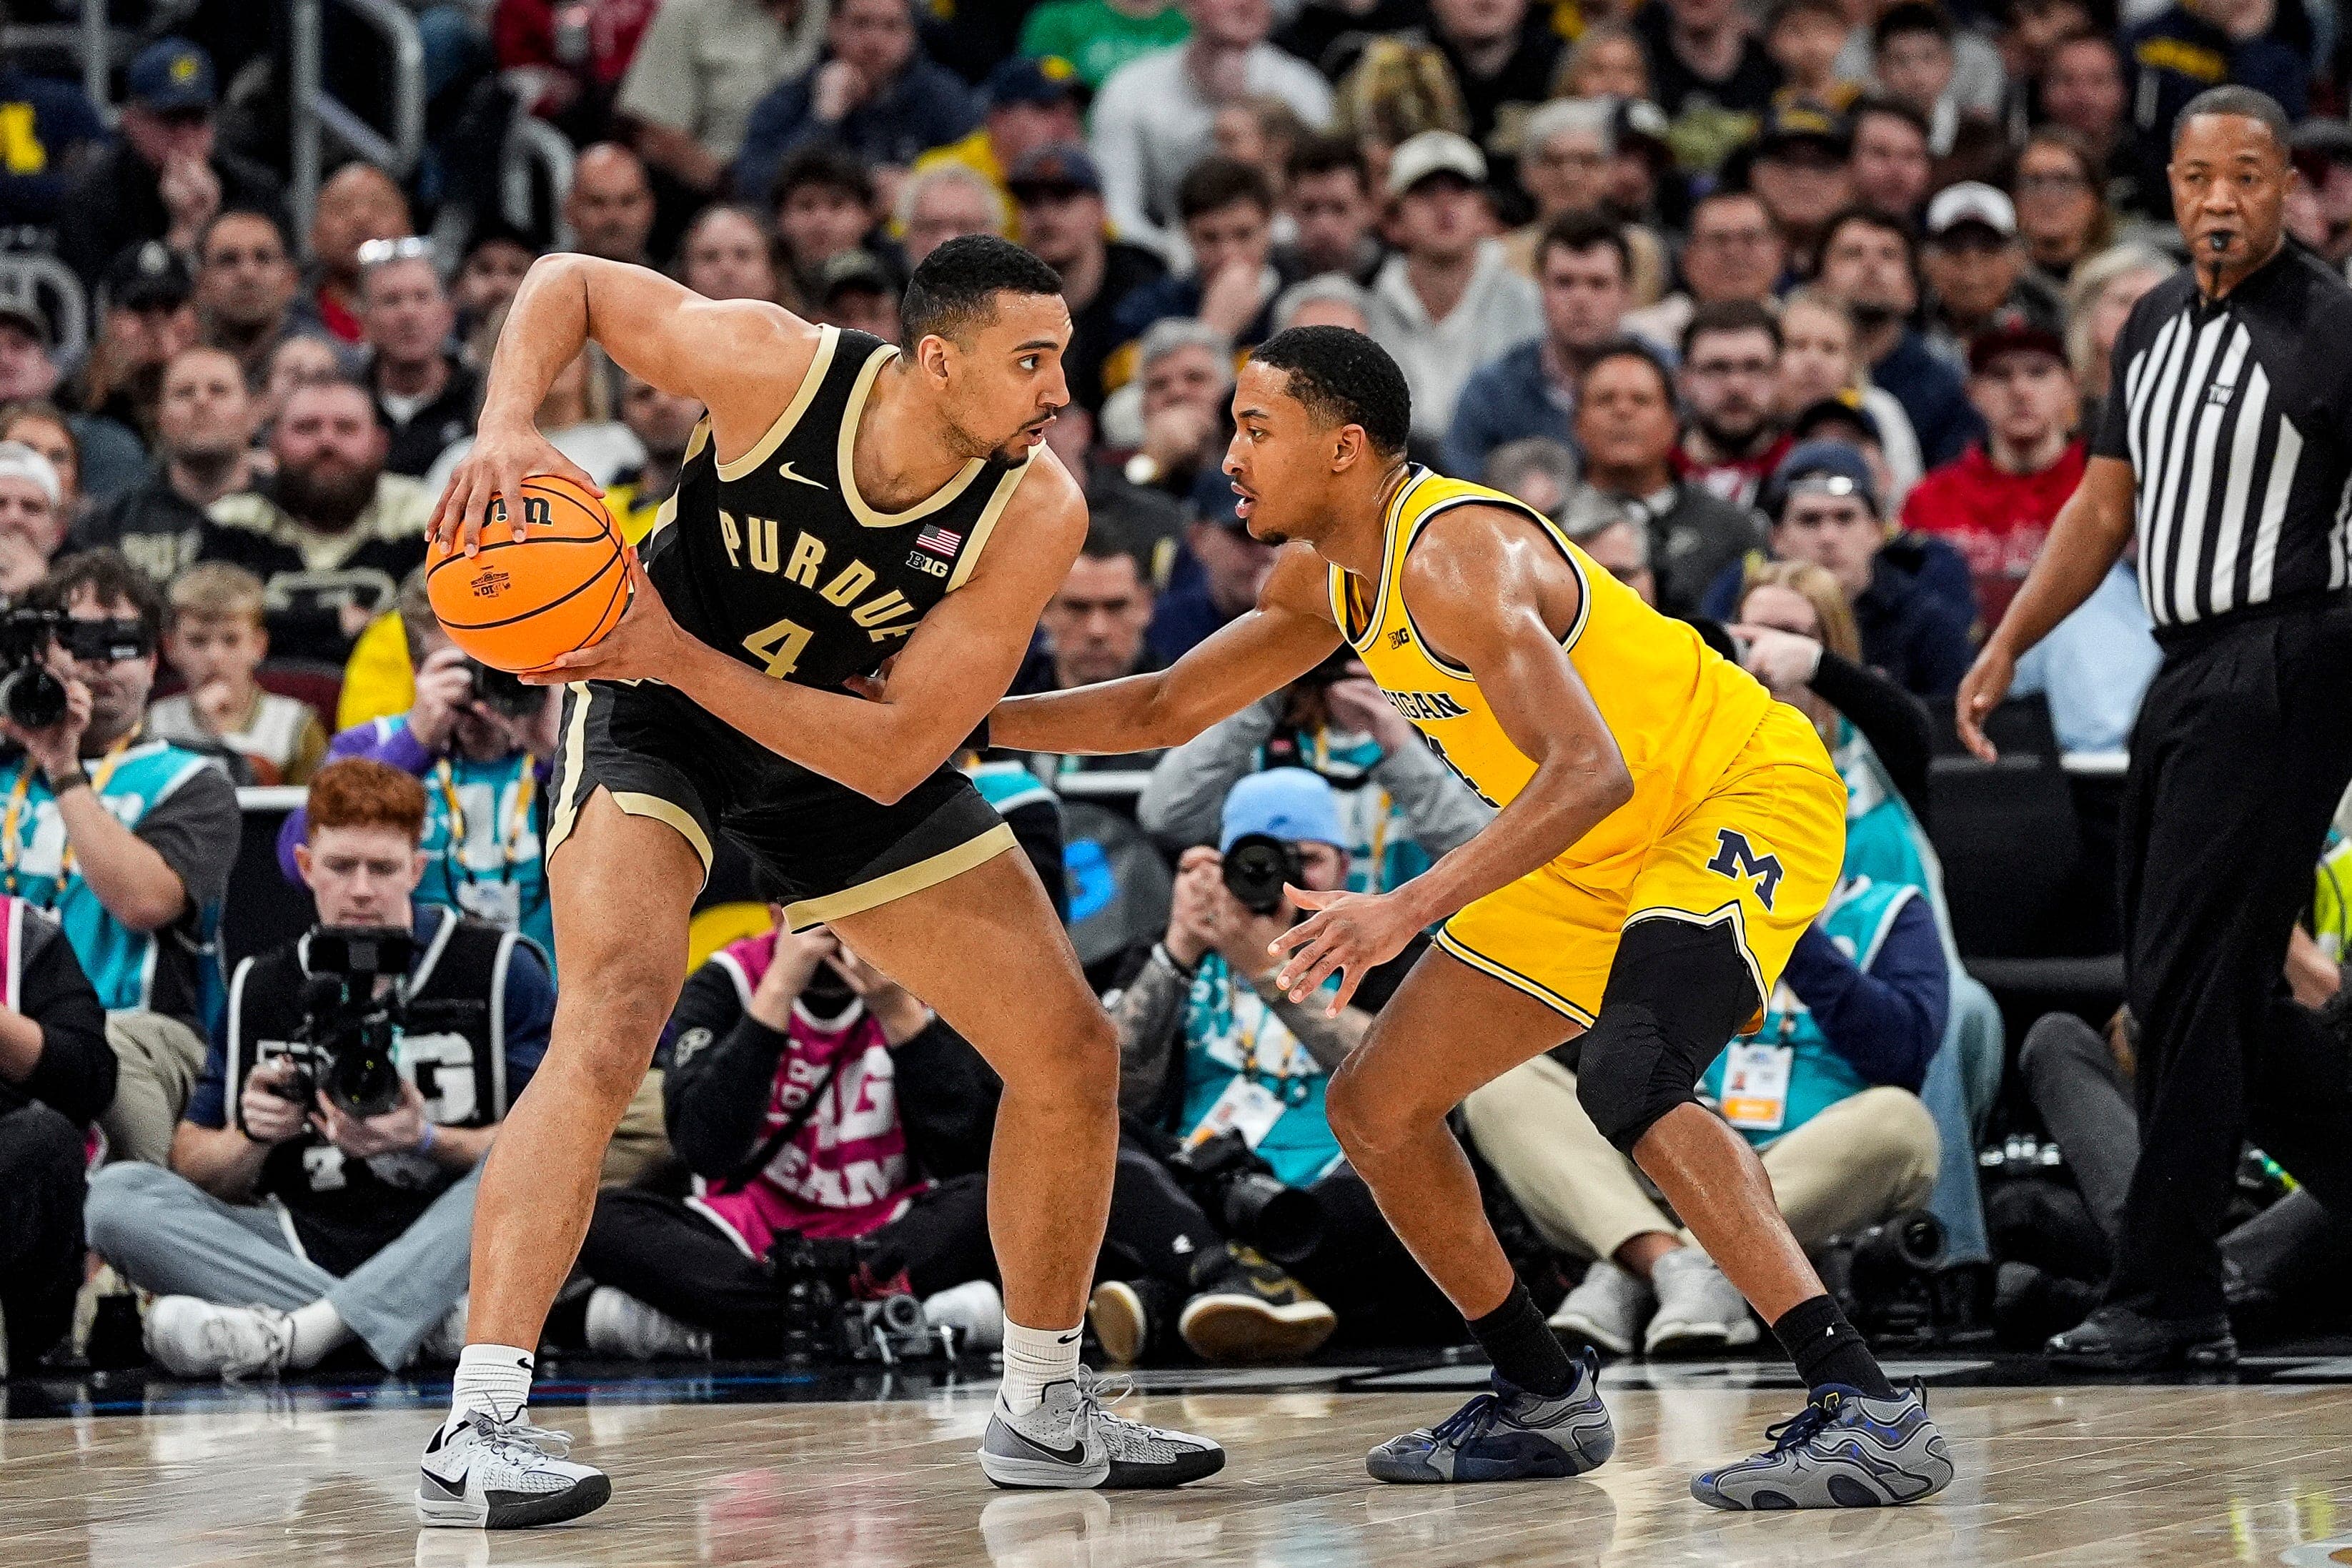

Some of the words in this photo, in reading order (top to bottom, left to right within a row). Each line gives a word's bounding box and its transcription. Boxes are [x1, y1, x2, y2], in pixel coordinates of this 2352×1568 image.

[718, 507, 921, 643] PURDUE
[742, 618, 815, 680] 4
[1707, 828, 1784, 912] M
